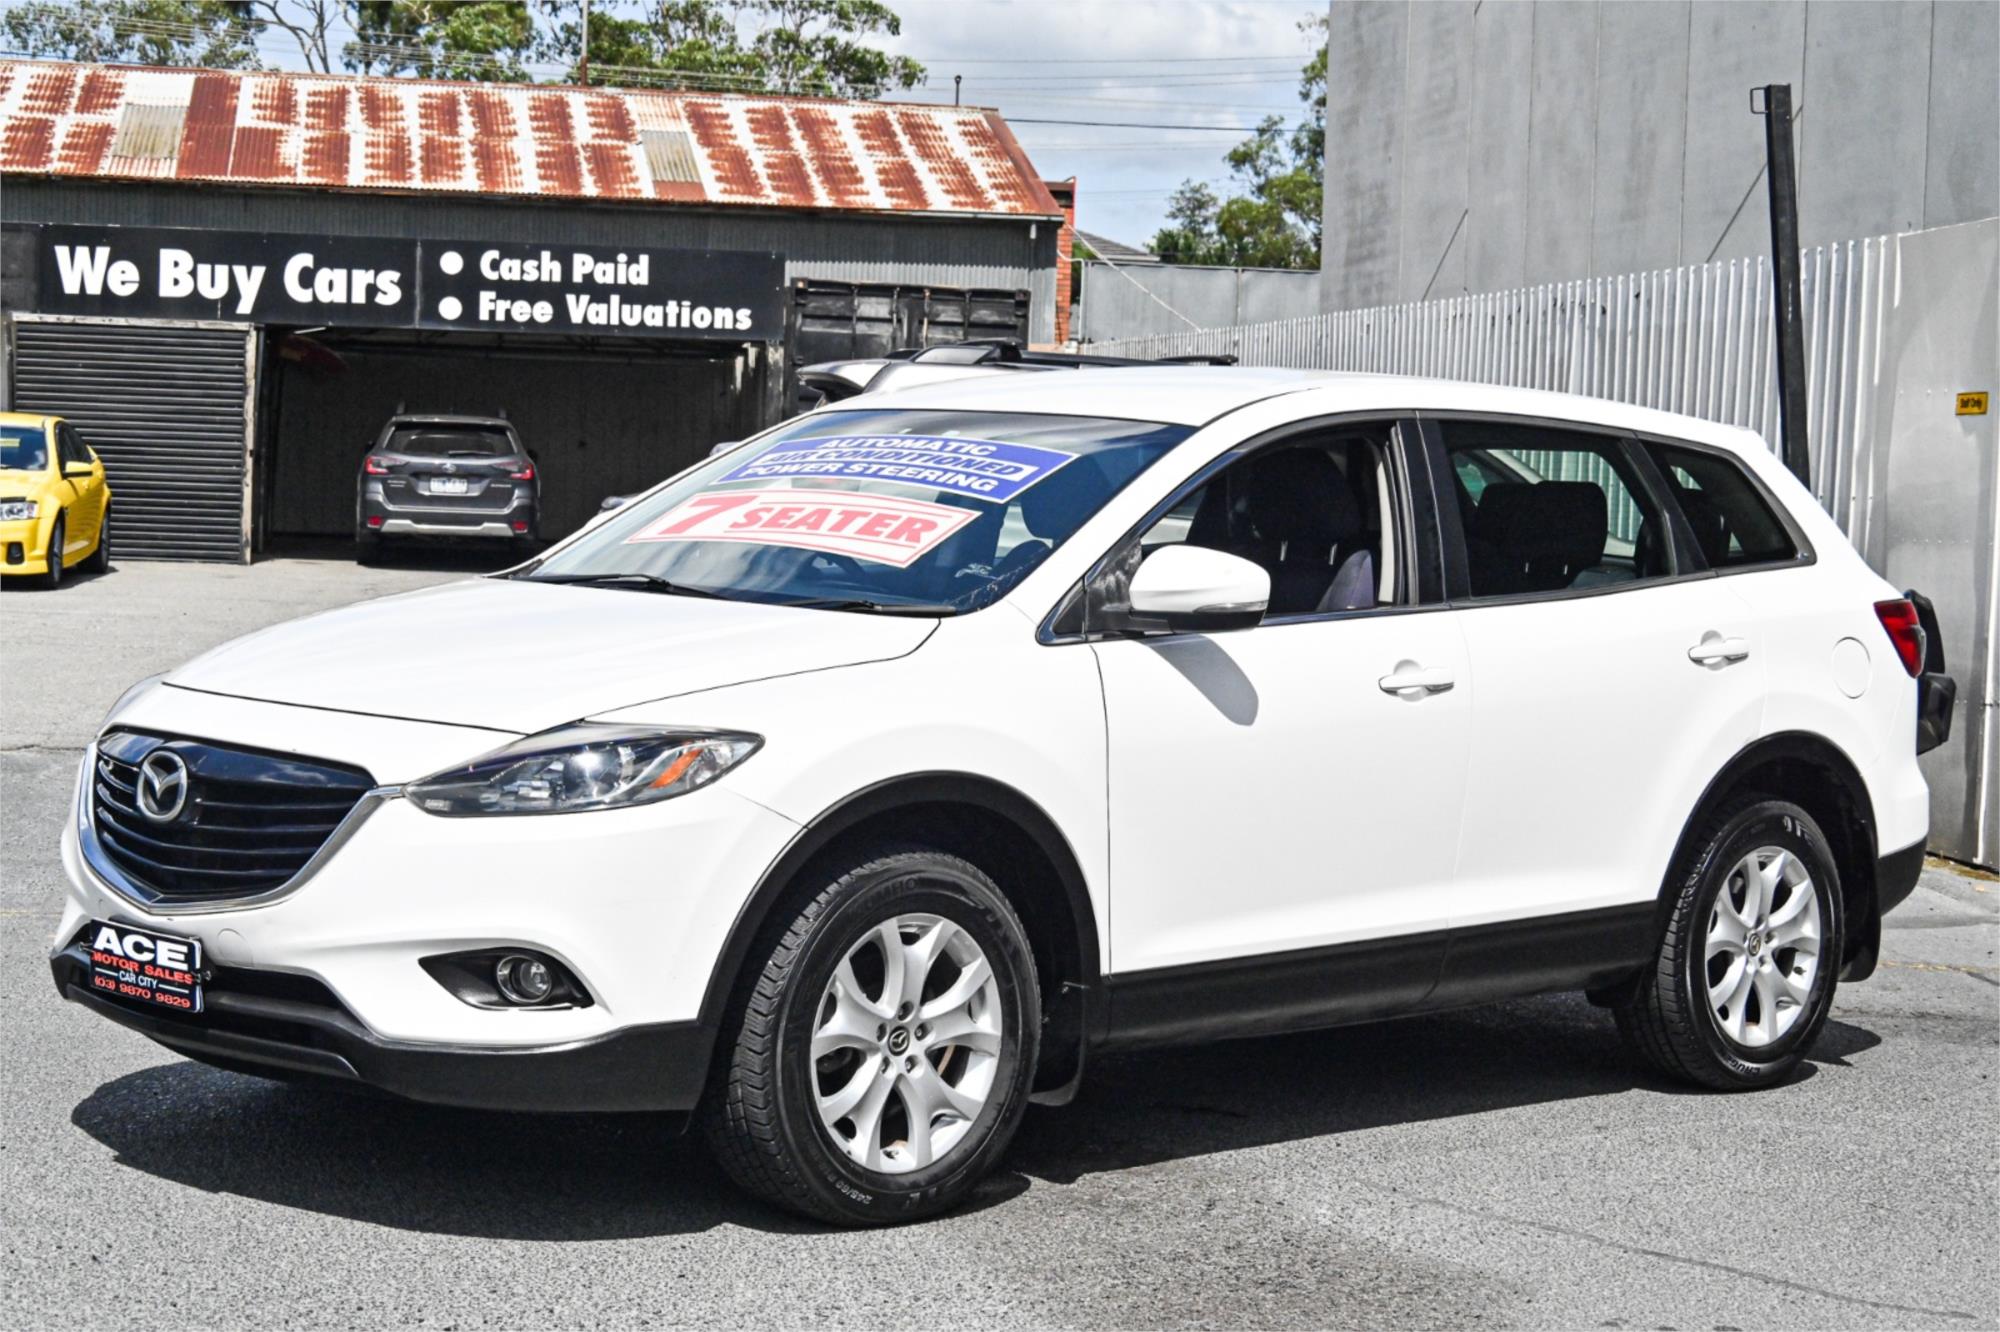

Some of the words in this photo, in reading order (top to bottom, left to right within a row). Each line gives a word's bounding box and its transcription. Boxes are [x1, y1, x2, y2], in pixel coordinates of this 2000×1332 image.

[54, 245, 140, 296] We
[158, 248, 266, 315] Buy
[283, 252, 402, 306] Cars
[479, 250, 562, 283] Cash
[572, 253, 649, 285] Paid
[478, 290, 553, 323] Free
[565, 293, 752, 331] Valuations
[815, 438, 997, 456] AUTOMATIC
[816, 449, 1025, 476] CONDITIONED
[738, 463, 845, 478] POWER
[843, 462, 999, 492] STEERING
[657, 495, 759, 535] 7
[728, 506, 938, 543] SEATER
[93, 926, 189, 971] ACE
[91, 951, 139, 972] MOTOR
[144, 964, 194, 985] SALES
[118, 970, 137, 984] CAR
[137, 976, 159, 989] CITY
[94, 975, 116, 991] (03)
[119, 983, 151, 999] 9870
[155, 992, 191, 1008] 9829
